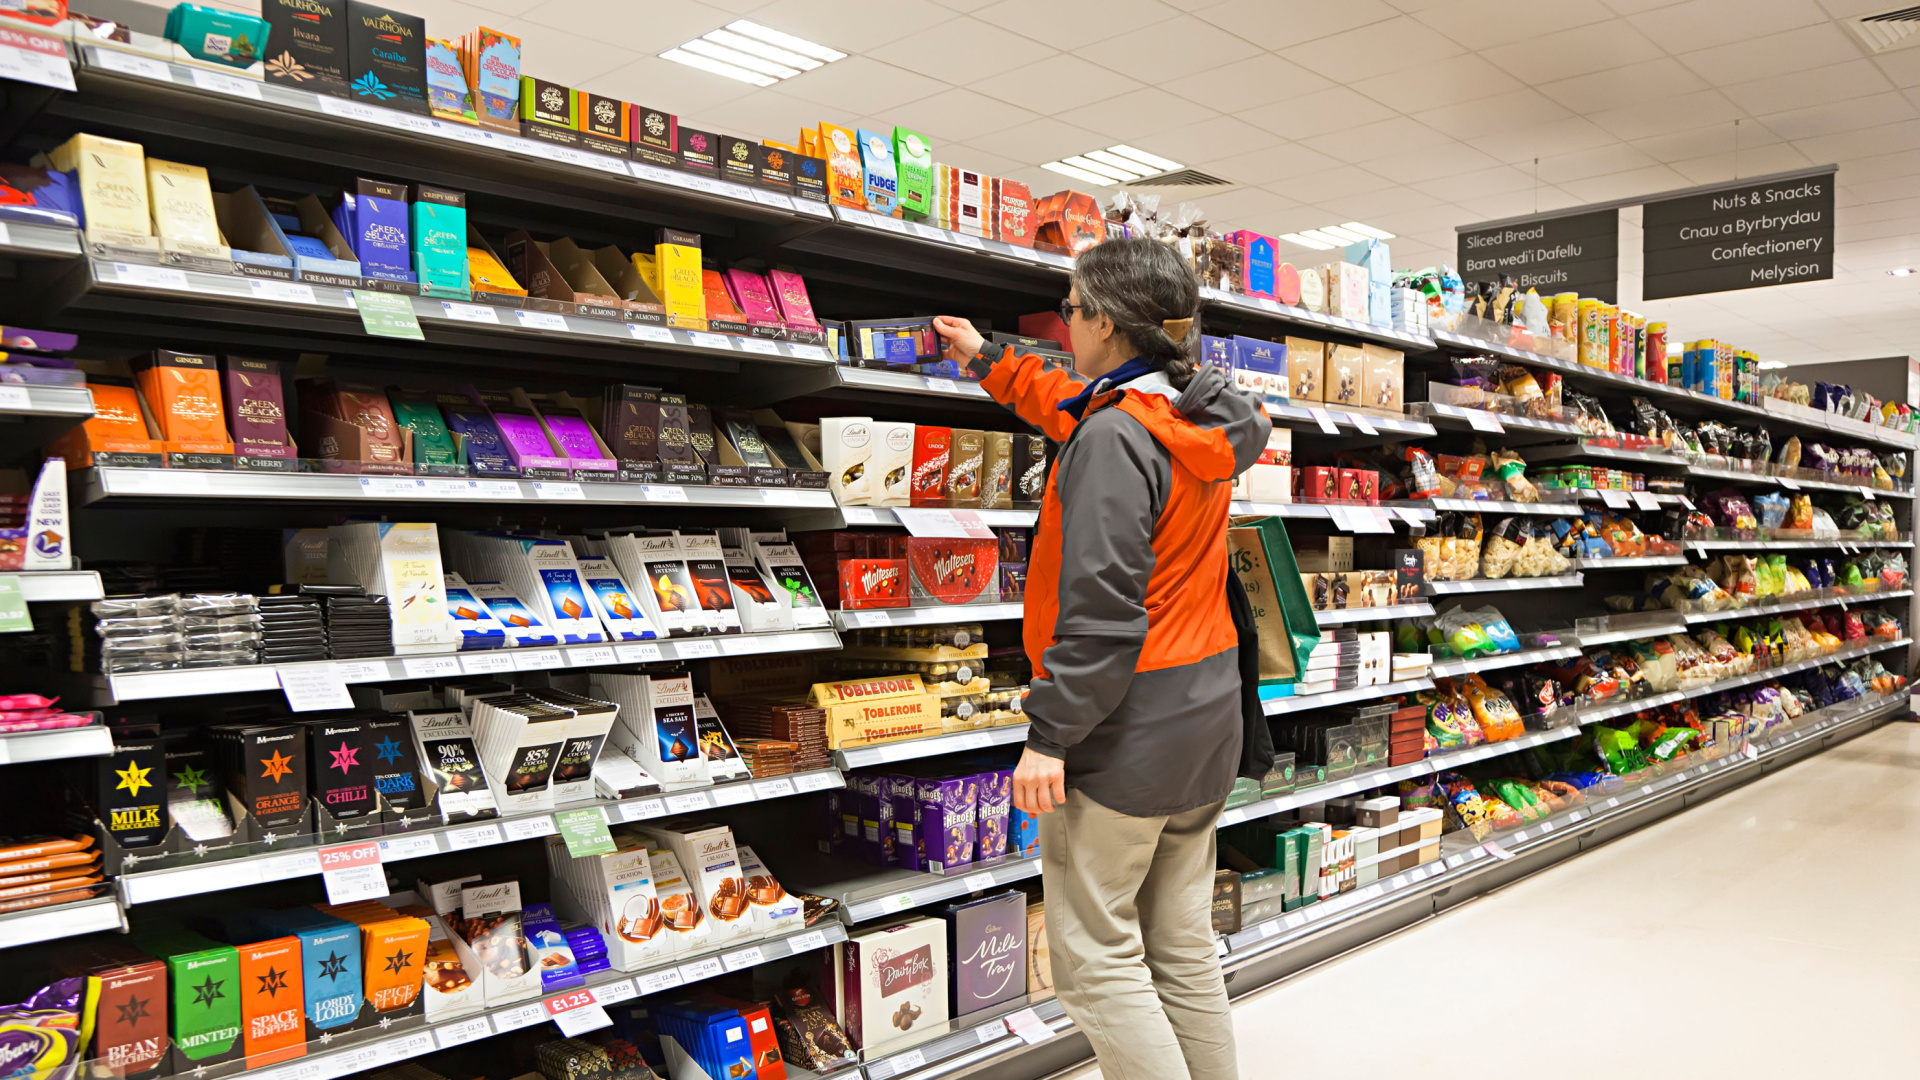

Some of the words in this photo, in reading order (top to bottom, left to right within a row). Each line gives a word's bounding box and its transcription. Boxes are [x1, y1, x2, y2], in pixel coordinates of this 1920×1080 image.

[362, 16, 413, 38] VALRHONA
[293, 27, 320, 42] Jivara
[29, 37, 62, 52] OFF
[372, 47, 407, 63] Caraïbe
[486, 58, 516, 73] GRENADA
[482, 64, 519, 80] CHOCOLATE
[869, 173, 896, 192] FUDGE
[376, 187, 392, 195] MILK
[1713, 194, 1746, 211] Nuts
[1750, 191, 1761, 205] &
[1765, 183, 1821, 203] Snacks
[1065, 208, 1087, 223] Chocolate
[1086, 213, 1102, 228] Ginger
[369, 223, 402, 235] GREEN
[1680, 225, 1718, 240] Cnau
[1722, 223, 1732, 234] a
[1736, 210, 1821, 235] Byrbrydau
[1467, 231, 1502, 249] Sliced
[1505, 225, 1544, 243] Bread
[372, 242, 399, 251] ORGANIC
[1712, 237, 1823, 260] Confectionery
[1467, 258, 1496, 271] Bara
[1499, 249, 1535, 266] wedi'i
[1537, 244, 1582, 261] Dafellu
[244, 267, 270, 277] CREAMY
[270, 269, 291, 279] MILK
[1521, 269, 1568, 287] Biscuits
[1750, 262, 1819, 282] Melysion
[304, 273, 338, 285] CREAMY
[338, 277, 358, 287] MILK
[590, 307, 617, 317] ALMOND
[635, 313, 660, 322] ALMOND
[720, 323, 732, 331] MAYA
[733, 323, 747, 332] GOLD
[176, 356, 204, 365] GINGER
[243, 398, 277, 409] GREEN
[247, 417, 276, 425] ORGANIC
[628, 424, 653, 434] GREEN
[662, 427, 685, 435] GREEN
[847, 428, 863, 437] Lindt
[113, 455, 149, 464] GINGER
[188, 455, 223, 465] GINGER
[251, 459, 283, 468] CHERRY
[644, 471, 658, 480] 70%
[690, 473, 704, 481] 70%
[735, 475, 747, 484] 70%
[762, 476, 774, 484] DARK
[774, 476, 787, 485] 85%
[36, 518, 62, 526] NEW
[642, 540, 668, 550] Lindt
[685, 537, 711, 548] Lindt
[537, 549, 559, 559] Lindt
[767, 547, 789, 557] Lindt
[581, 562, 602, 571] Lindt
[654, 567, 679, 575] INTENSE
[933, 552, 975, 586] Maltesers
[862, 565, 899, 596] Maltesers
[657, 681, 682, 693] Lindt
[833, 678, 916, 701] TOBLERONE
[863, 703, 923, 721] TOBLERONE
[423, 714, 452, 727] Lindt
[675, 715, 689, 723] SALT
[324, 726, 361, 736] Montezuma's
[423, 730, 467, 738] EXCELLENCE
[864, 723, 924, 742] TOBLERONE
[256, 733, 295, 745] Montezuma's
[438, 744, 465, 759] 90%
[571, 740, 593, 753] 70%
[525, 747, 550, 762] 85%
[567, 750, 589, 758] COCOA
[523, 759, 546, 767] COCOA
[384, 772, 400, 780] COCOA
[376, 776, 415, 790] DARK
[256, 795, 300, 809] ORANGE
[326, 790, 367, 805] CHILLI
[261, 804, 300, 815] GERANIUM
[111, 808, 160, 826] MILK
[110, 821, 161, 832] CHOCOLATE
[532, 821, 549, 830] £1.78
[478, 829, 495, 837] £1.83
[703, 838, 724, 854] Lindt
[323, 850, 351, 865] 25%
[352, 847, 377, 860] OFF
[707, 852, 730, 862] CREATION
[616, 870, 643, 881] CREATION
[363, 881, 385, 890] £1.79
[472, 887, 501, 901] Lindt
[962, 933, 1023, 965] Milk
[883, 964, 912, 987] Dairy
[911, 953, 929, 976] Box
[662, 972, 677, 982] £2.49
[973, 954, 1016, 999] Tray
[374, 984, 415, 1000] SPICE
[614, 984, 630, 993] £1.25
[315, 994, 356, 1014] LORDY
[374, 997, 389, 1009] IT
[394, 992, 414, 1006] UP
[552, 992, 590, 1012] £1.25
[251, 1009, 298, 1026] SPACE
[315, 1003, 356, 1022] LORD
[522, 1007, 539, 1017] £2.13
[251, 1019, 299, 1039] HOPPER
[467, 1021, 485, 1032] £2.13
[181, 1026, 240, 1050] MINTED
[409, 1036, 427, 1047] £1.79
[107, 1037, 160, 1061] BEAN
[358, 1049, 377, 1060] £1.79
[108, 1049, 160, 1069] MACHINE
